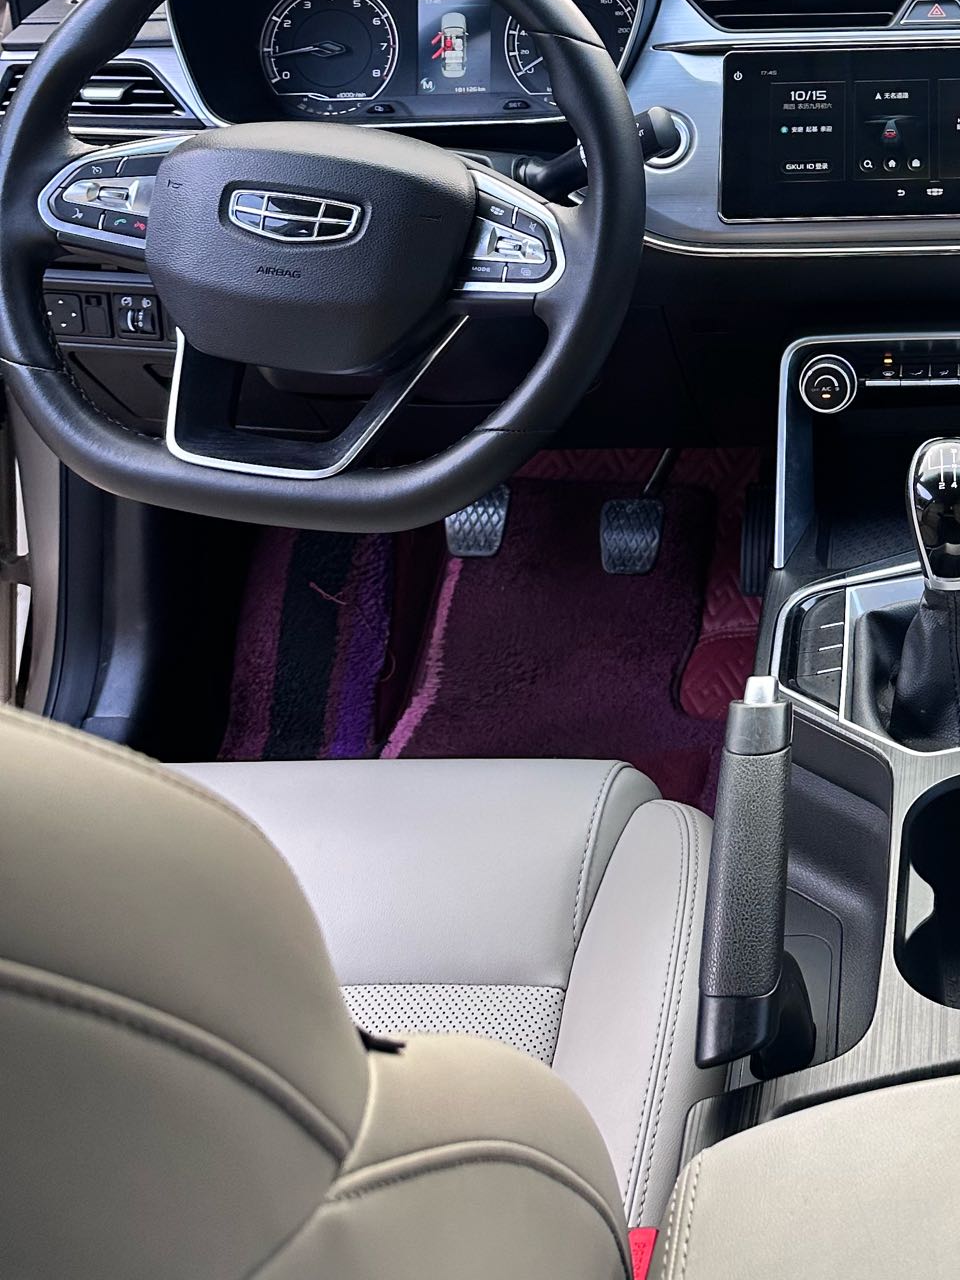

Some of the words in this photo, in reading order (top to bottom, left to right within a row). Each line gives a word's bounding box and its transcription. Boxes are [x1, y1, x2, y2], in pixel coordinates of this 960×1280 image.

[303, 1, 312, 9] 3
[283, 20, 292, 28] 2
[372, 17, 381, 25] 6
[282, 71, 291, 79] 0
[372, 69, 381, 77] 8
[422, 81, 433, 90] M
[790, 90, 827, 101] 10/15
[256, 265, 302, 279] AIRBAG
[938, 482, 946, 490] 2
[950, 481, 958, 489] 4
